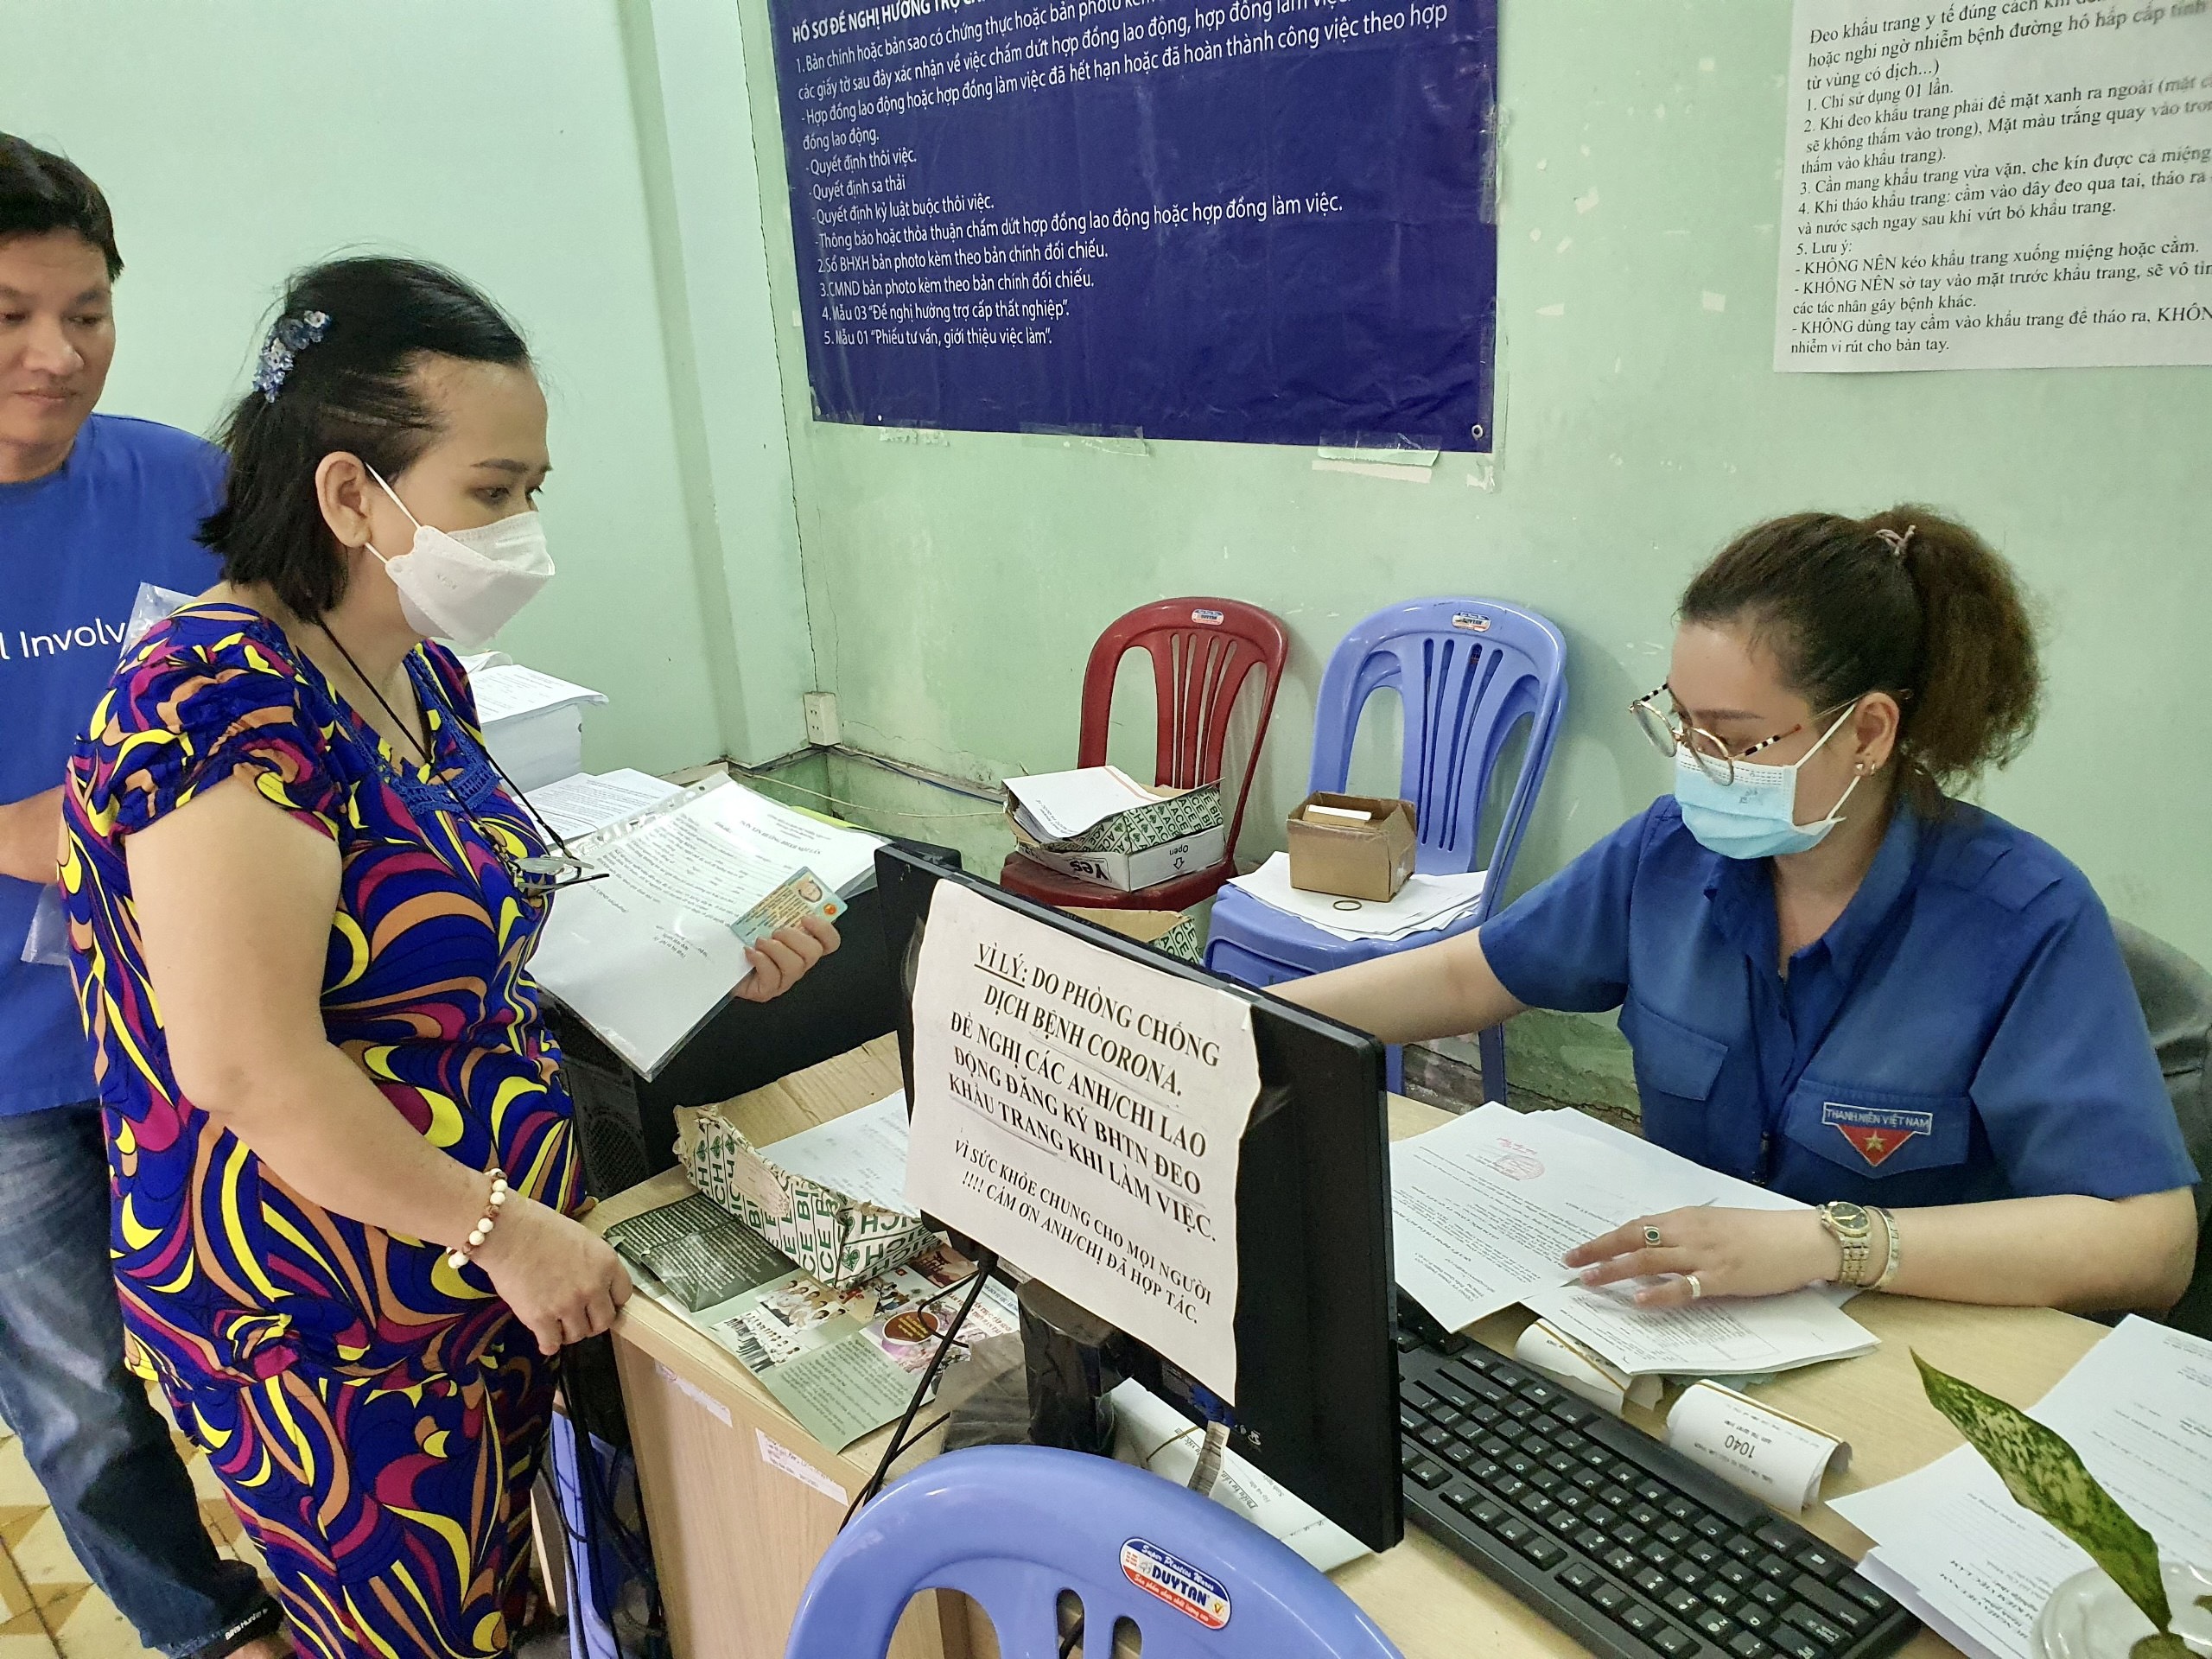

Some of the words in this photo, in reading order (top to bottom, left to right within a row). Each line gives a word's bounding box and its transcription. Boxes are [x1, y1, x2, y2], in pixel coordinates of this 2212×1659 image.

[1824, 136, 1863, 150] không
[847, 178, 869, 199] định
[872, 181, 882, 193] sa
[885, 173, 905, 192] thải
[850, 204, 873, 224] định
[875, 202, 887, 222] kỷ
[890, 200, 910, 219] luật
[912, 198, 939, 217] buộc
[942, 194, 964, 213] thôi
[968, 194, 994, 213] việc.
[854, 227, 874, 246] báo
[876, 228, 901, 246] hoặc
[904, 225, 927, 242] thỏa
[931, 223, 963, 243] thuận
[967, 218, 998, 238] chấm
[1001, 217, 1020, 235] dứt
[1023, 216, 1047, 237] hợp
[1052, 211, 1086, 233] đồng
[1090, 211, 1109, 229] lao
[1113, 207, 1149, 229] động
[1154, 204, 1188, 226] hoặc
[1193, 202, 1222, 224] hợp
[1226, 197, 1267, 221] đồng
[1273, 195, 1300, 215] làm
[1306, 192, 1343, 216] việc.
[1798, 222, 1811, 235] và
[1816, 219, 1847, 233] nước
[1852, 217, 1878, 232] sạch
[1884, 218, 1916, 231] ngay
[1922, 215, 1944, 226] sau
[1949, 209, 1971, 224] khi
[1978, 207, 2000, 220] vứt
[840, 256, 869, 271] BHXH
[872, 253, 892, 270] bản
[894, 252, 925, 273] photo
[928, 251, 952, 266] kèm
[955, 248, 981, 265] theo
[984, 245, 1006, 264] bản
[1009, 244, 1040, 262] chính
[1045, 241, 1064, 260] đối
[1068, 239, 1108, 258] chiếu.
[1805, 257, 1858, 274] KHÔNG
[1863, 254, 1896, 271] NÊN
[1902, 256, 1926, 269] kéo
[2013, 245, 2059, 264] xuống
[2065, 244, 2113, 261] miệng
[2119, 242, 2155, 258] hoặc
[862, 279, 882, 295] bản
[886, 278, 916, 298] photo
[918, 277, 941, 293] kèm
[944, 276, 969, 292] theo
[973, 273, 995, 291] bản
[998, 272, 1029, 290] chính
[1033, 270, 1052, 289] đối
[1055, 269, 1094, 288] chiếu.
[855, 306, 867, 320] 03
[890, 303, 912, 323] nghị
[953, 304, 969, 321] trợ
[972, 300, 992, 321] cấp
[995, 299, 1020, 317] thất
[1794, 302, 1813, 315] các
[1818, 301, 1834, 314] tác
[1838, 300, 1866, 312] nhân
[1872, 299, 1895, 315] gây
[1901, 296, 1933, 313] bệnh
[1939, 295, 1975, 308] khác.
[1802, 317, 1853, 334] KHÔNG
[1896, 321, 1916, 334] tay
[1955, 315, 1980, 328] vào
[2027, 315, 2063, 327] trang
[2094, 309, 2126, 323] tháo
[857, 330, 868, 344] 01
[906, 331, 917, 344] tư
[919, 327, 941, 346] vấn,
[944, 328, 963, 348] giới
[967, 327, 996, 347] thiệu
[1000, 327, 1023, 347] việc
[1169, 844, 1189, 857] Open
[1069, 861, 1109, 881] Yes
[1032, 966, 1059, 995] DO
[1061, 979, 1133, 1028] PHÒNG
[1137, 1014, 1220, 1066] CHỐNG
[983, 984, 1031, 1023] DỊCH
[1032, 1005, 1086, 1049] BỆNH
[1087, 1033, 1182, 1096] CORONA.
[976, 1023, 1022, 1069] NGHỊ
[1025, 1049, 1065, 1085] CÁC
[1159, 1115, 1206, 1158] LAO
[954, 1046, 1001, 1087] ĐỘNG
[1005, 1072, 1058, 1116] ĐĂNG
[1063, 1102, 1089, 1134] KÝ
[1094, 1119, 1148, 1168] BHTN
[1154, 1152, 1201, 1195] ĐEO
[1905, 1117, 1929, 1128] NAM
[949, 1072, 995, 1115] KHẨU
[998, 1101, 1064, 1151] TRANG
[1067, 1137, 1103, 1175] KHI
[1109, 1160, 1152, 1207] LÀM
[1155, 1190, 1217, 1242] VIỆC.
[955, 1140, 969, 1158] VÌ
[970, 1148, 998, 1173] SỨC
[1000, 1165, 1037, 1197] KHỎE
[1039, 1187, 1091, 1227] CHUNG
[1094, 1219, 1123, 1248] CHO
[1127, 1240, 1154, 1270] MỌI
[1159, 1262, 1211, 1306] NGƯỜI
[1019, 1202, 1040, 1224] ƠN
[1107, 1252, 1127, 1277] ĐÃ
[1130, 1268, 1162, 1298] HỢP
[1725, 1435, 1755, 1459] 1040
